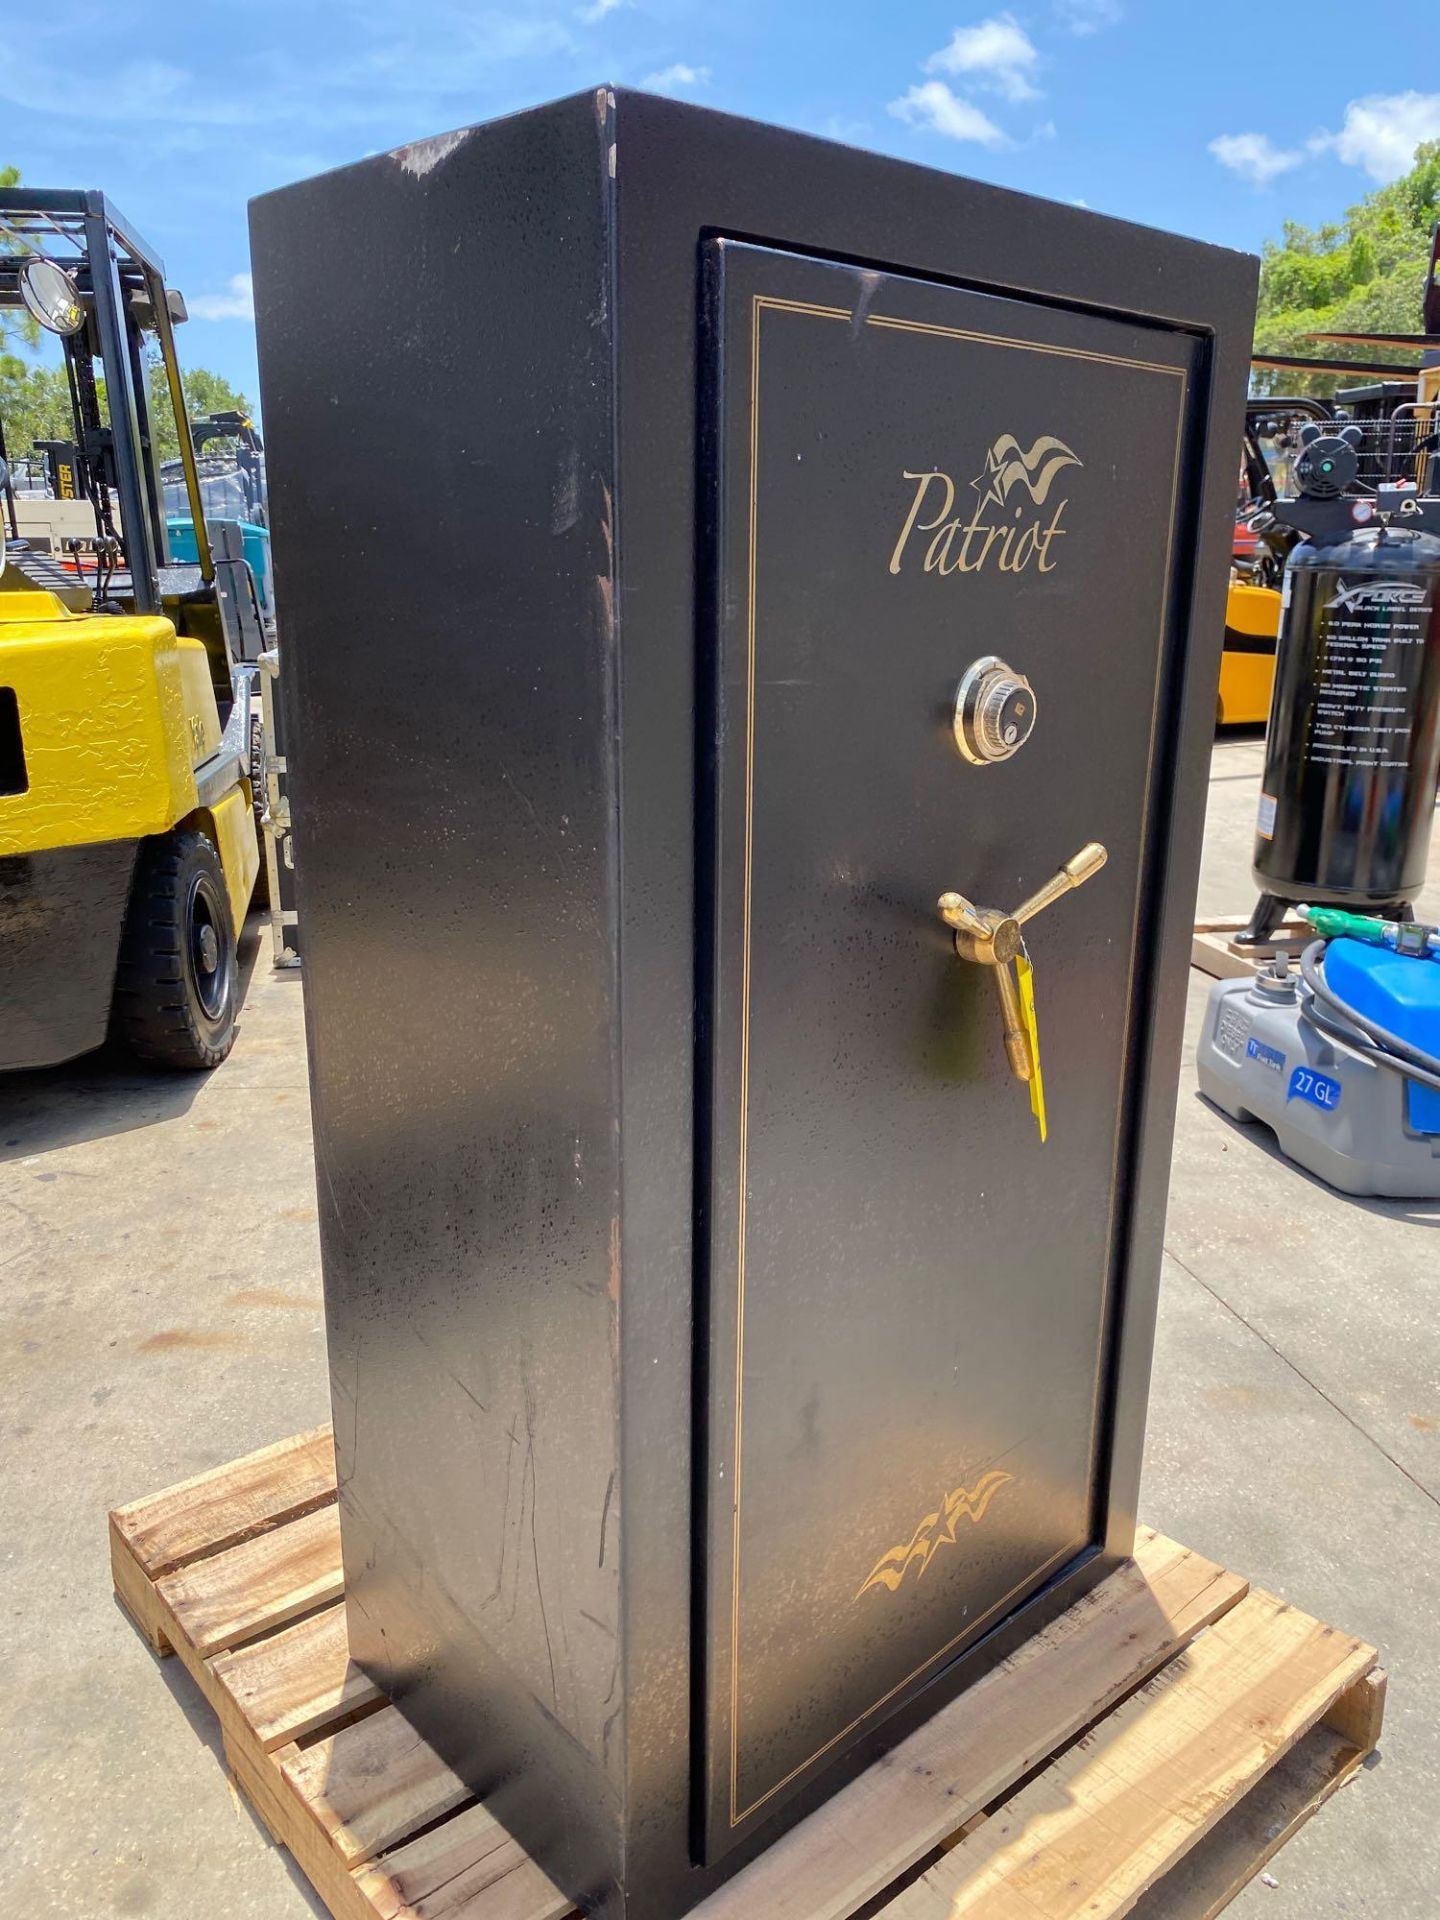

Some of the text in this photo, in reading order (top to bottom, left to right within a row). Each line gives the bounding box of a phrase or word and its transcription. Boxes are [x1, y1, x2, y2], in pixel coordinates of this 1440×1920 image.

[889, 470, 1069, 576] Patriot
[1295, 1071, 1332, 1105] 27 GL
